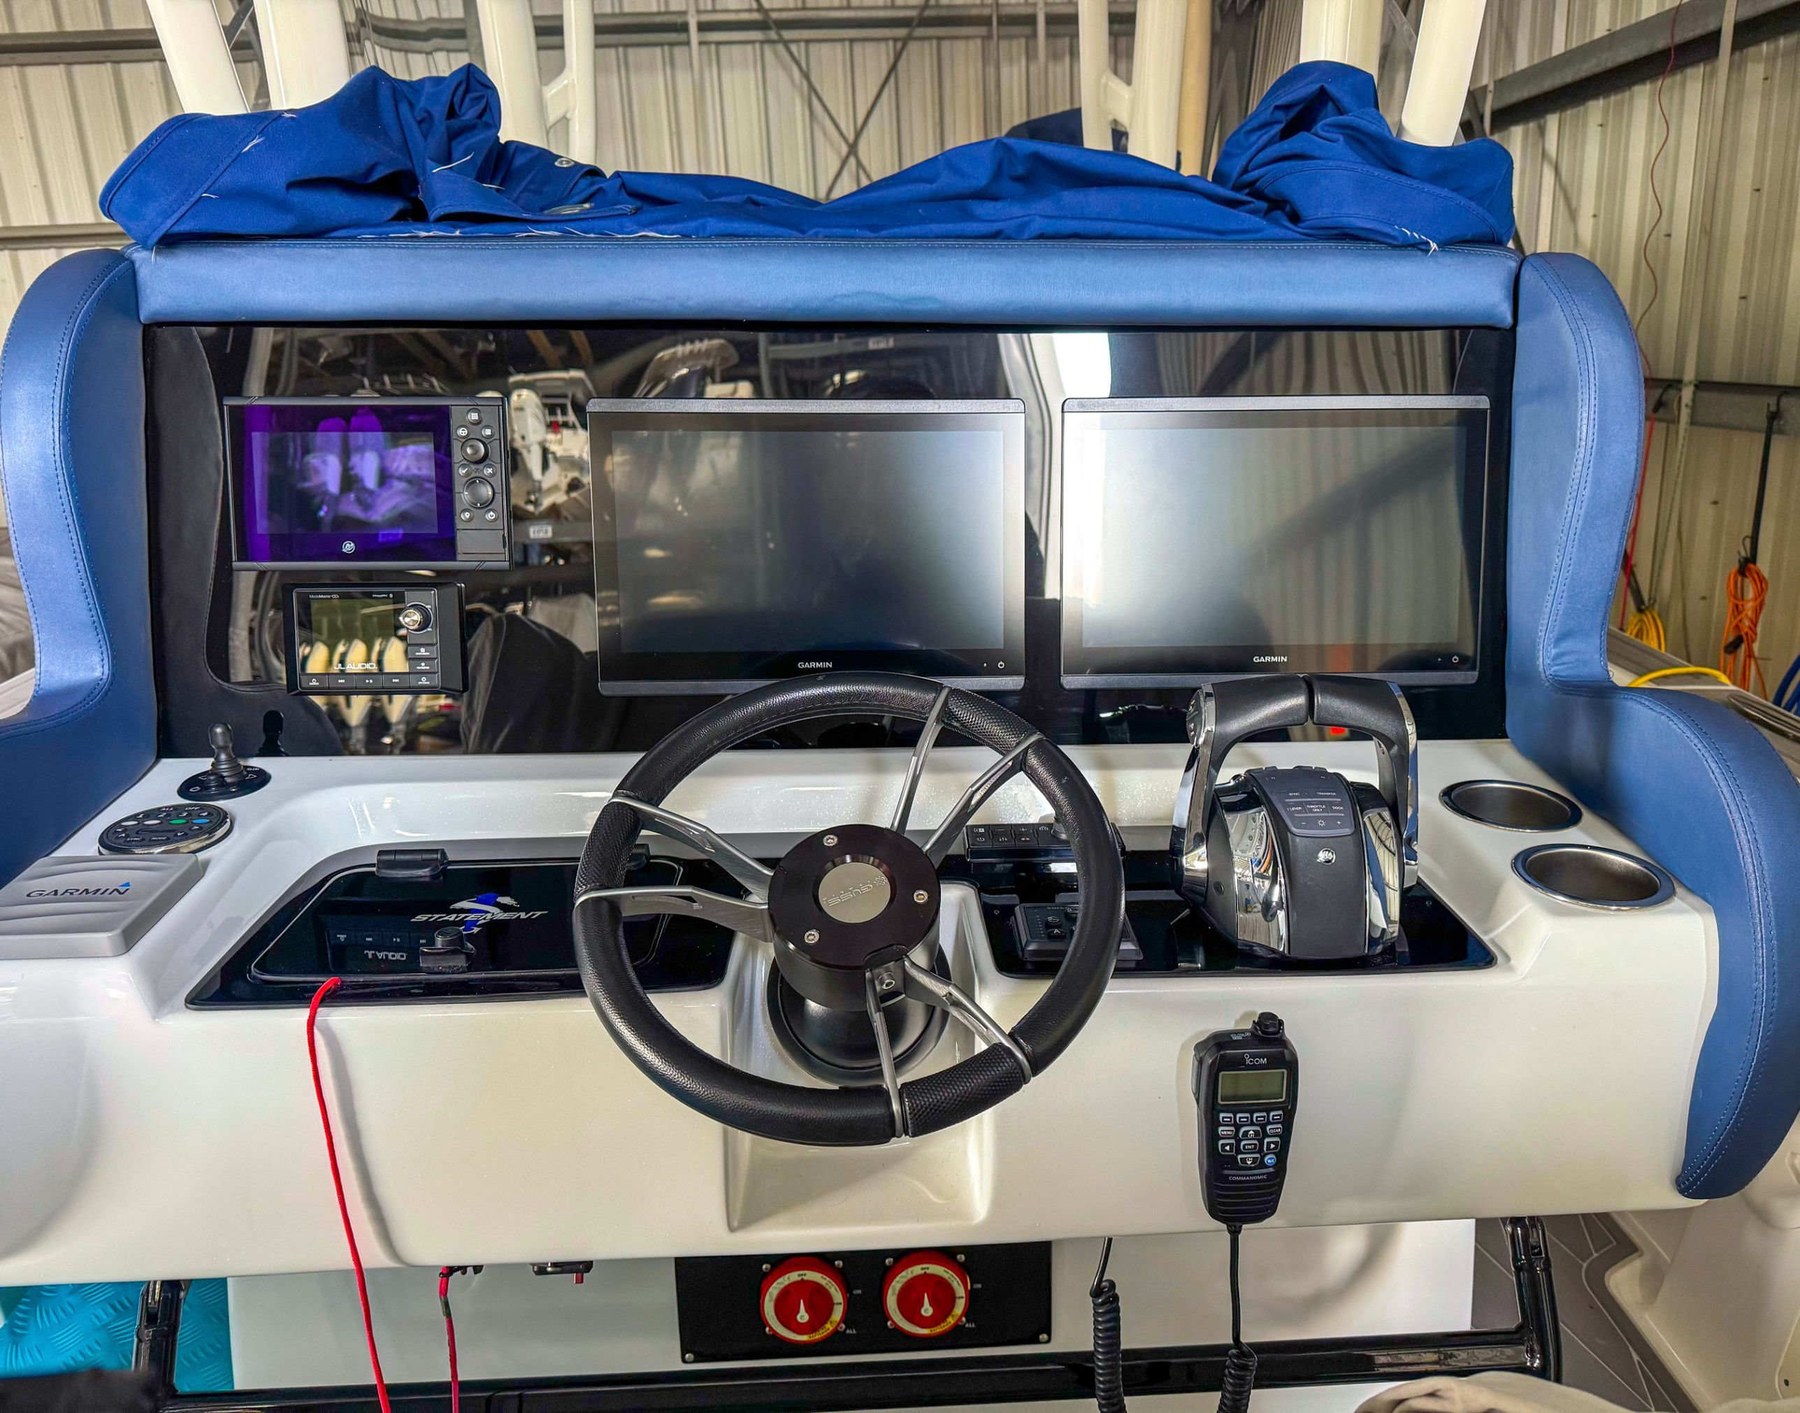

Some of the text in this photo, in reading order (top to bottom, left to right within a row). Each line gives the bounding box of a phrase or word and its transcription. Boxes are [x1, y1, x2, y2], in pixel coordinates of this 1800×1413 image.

[1253, 655, 1288, 663] GARMIN
[797, 661, 833, 669] GARMIN
[26, 887, 130, 898] GARMIN
[410, 910, 549, 922] STATEMENT
